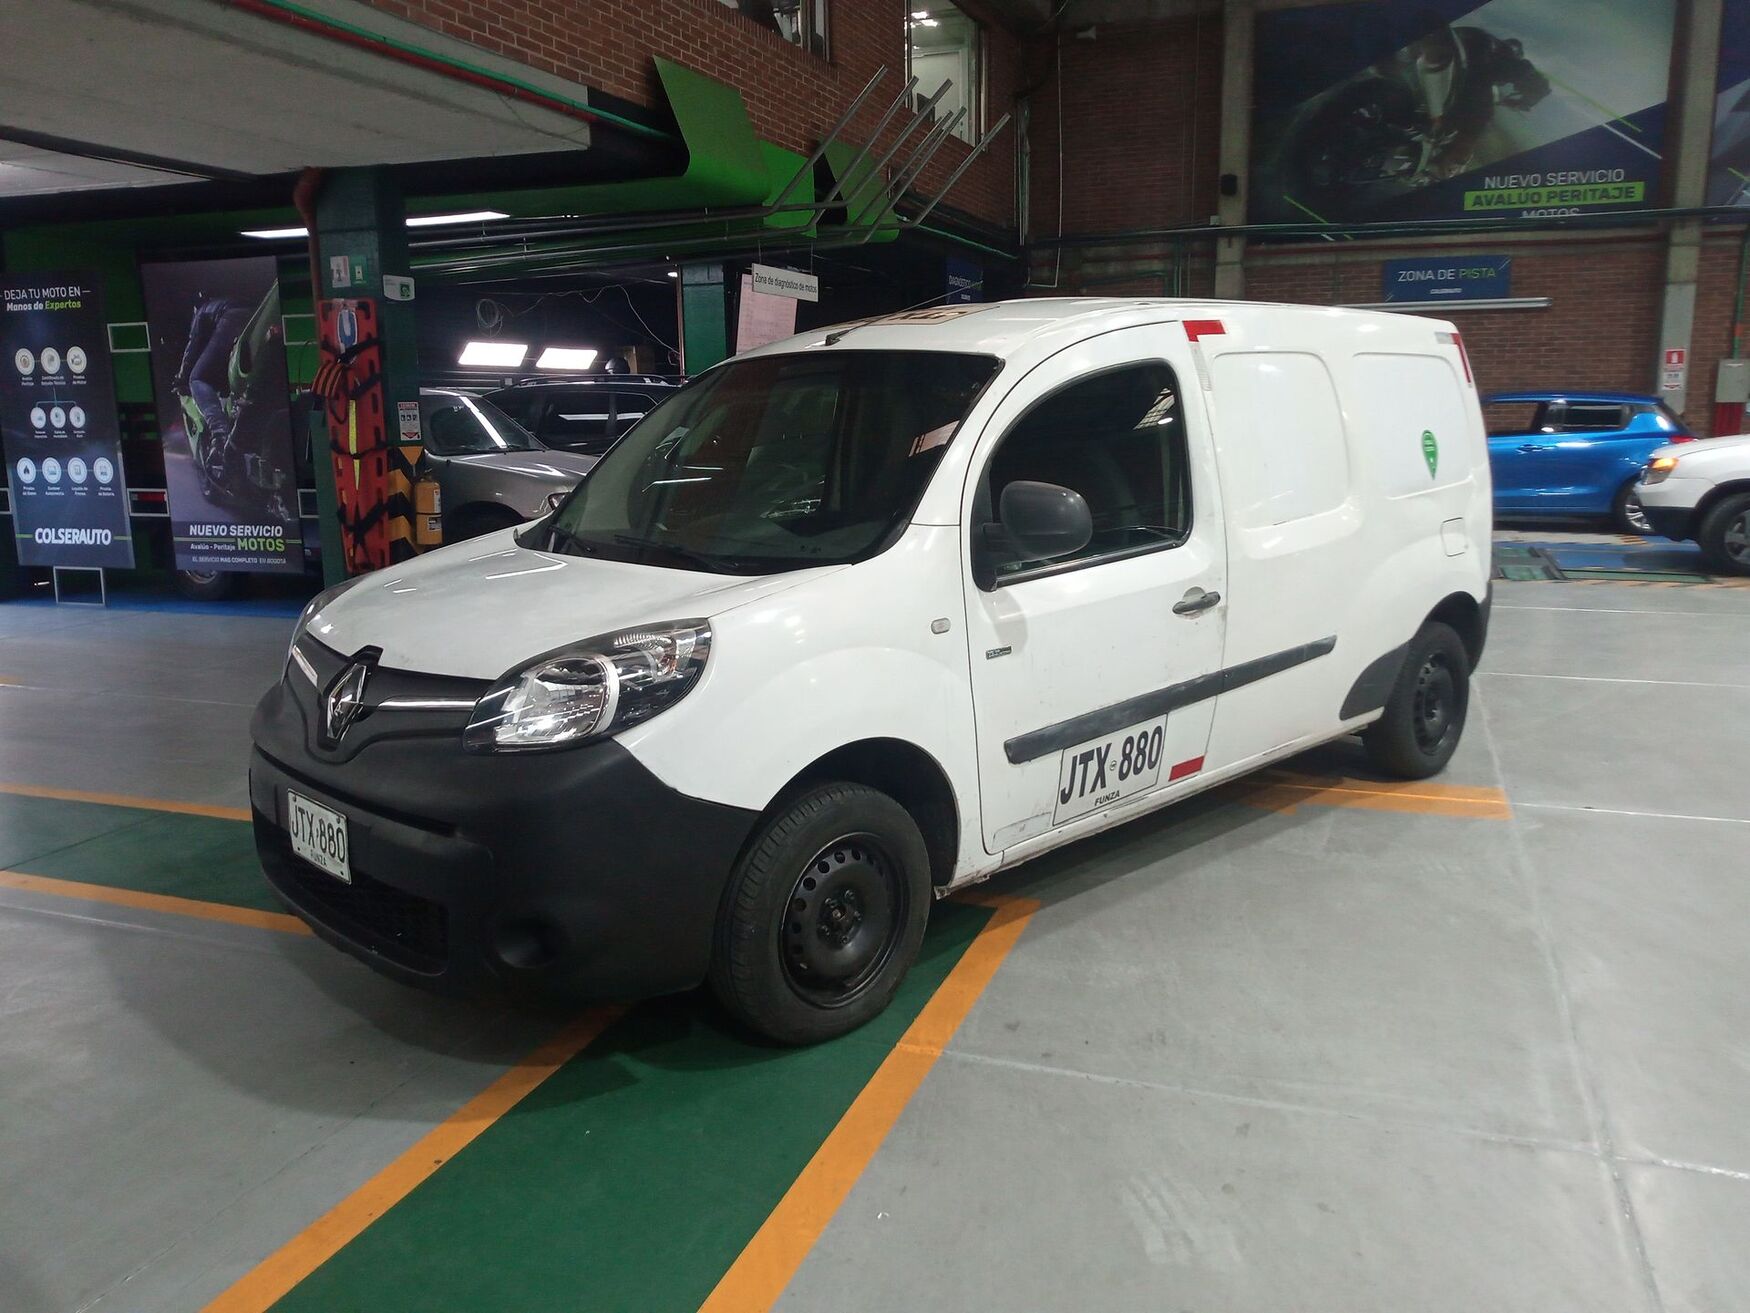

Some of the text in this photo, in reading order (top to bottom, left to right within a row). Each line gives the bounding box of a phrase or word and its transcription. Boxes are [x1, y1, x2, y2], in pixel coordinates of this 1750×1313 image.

[1484, 168, 1625, 189] NUEVO SERVICIO
[1545, 186, 1635, 203] PERITAJE
[754, 272, 767, 285] Zona
[1398, 267, 1496, 282] ZONA DE PISTA
[4, 286, 81, 301] DEJA TU MOTO EN
[6, 299, 82, 312] Manos de Expertos
[34, 527, 112, 546] COLSERAUTO
[189, 524, 283, 537] NUEVO SERVICIO
[213, 543, 236, 552] Peritaje
[237, 538, 285, 552] MOTOS
[1060, 725, 1163, 805] JTX 880
[1094, 790, 1120, 806] FUNZA
[292, 805, 346, 864] JTX 880
